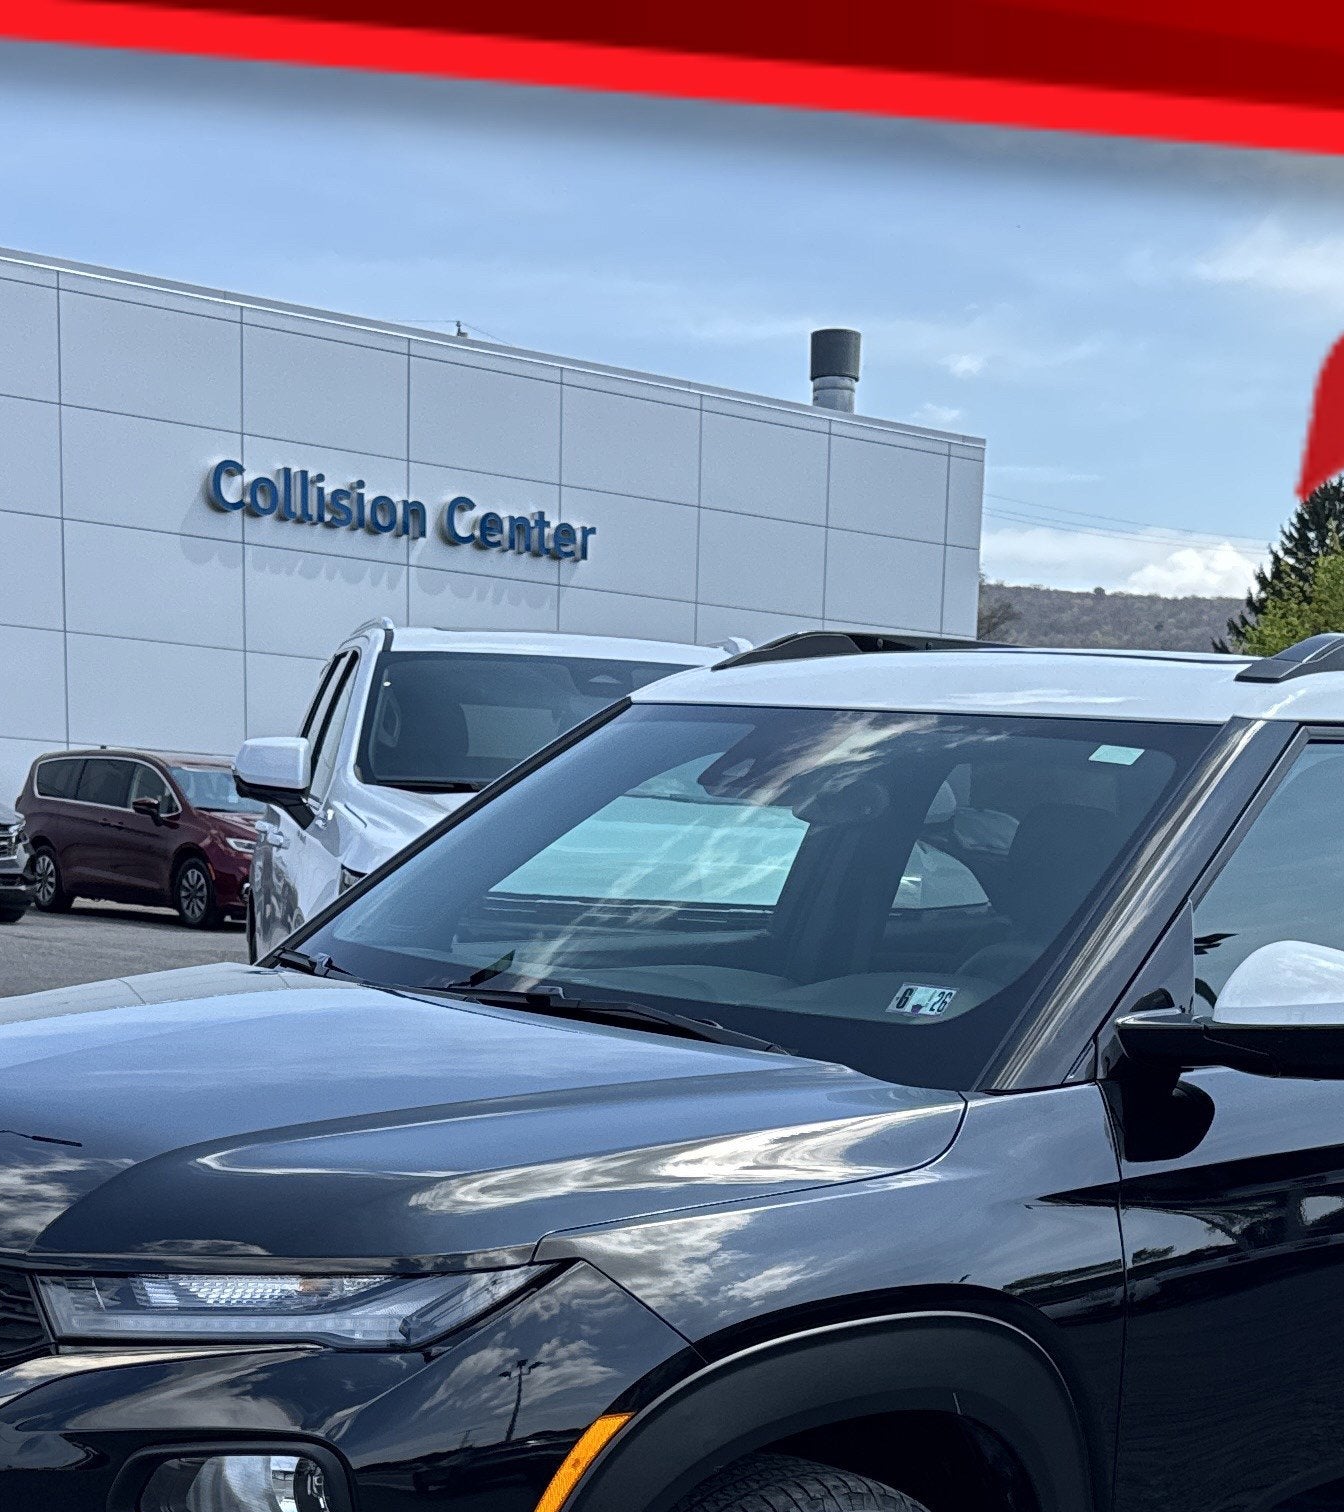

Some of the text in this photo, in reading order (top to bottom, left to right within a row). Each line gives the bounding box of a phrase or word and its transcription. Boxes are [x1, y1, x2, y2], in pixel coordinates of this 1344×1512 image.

[209, 459, 597, 561] Collision Center
[929, 991, 954, 1013] 26
